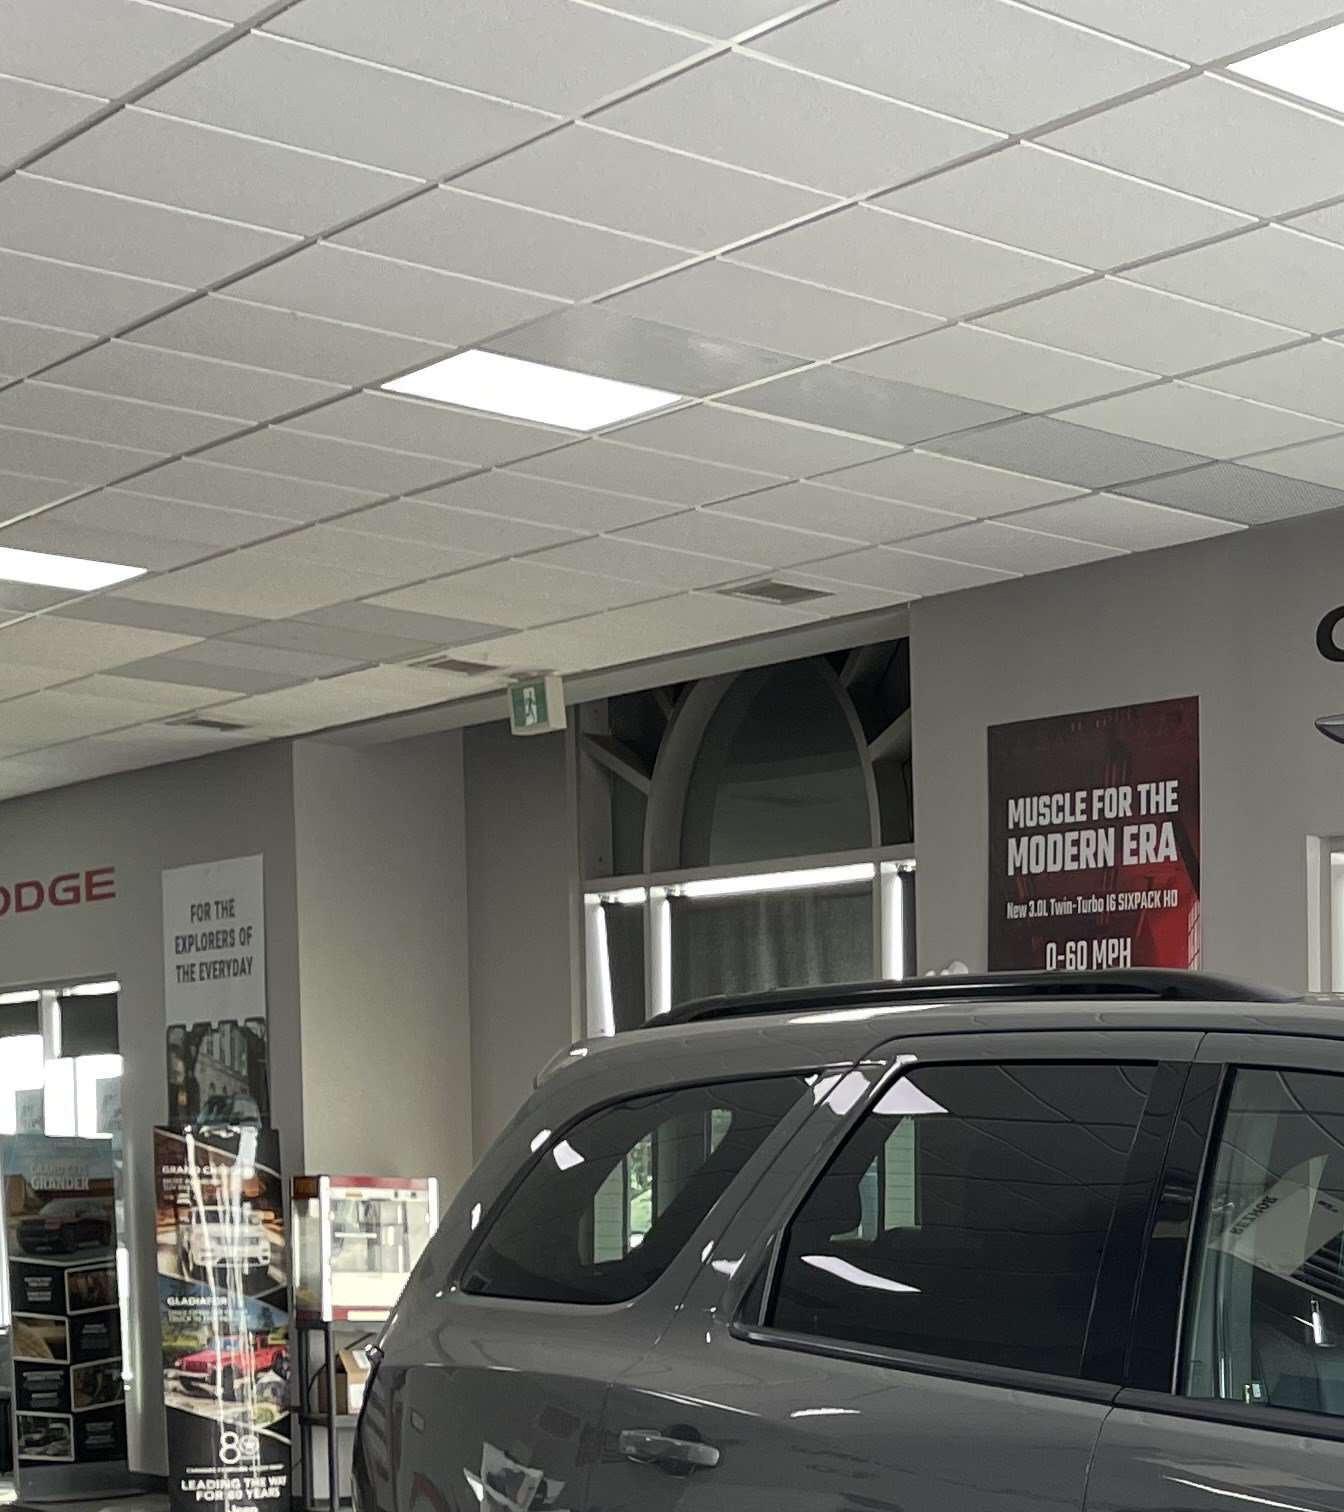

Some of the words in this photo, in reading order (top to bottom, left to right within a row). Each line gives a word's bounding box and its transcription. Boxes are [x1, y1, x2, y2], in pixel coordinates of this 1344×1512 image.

[1007, 790, 1087, 830] MUSCLE
[1093, 786, 1132, 821] FOR
[1137, 780, 1179, 816] THE
[1007, 827, 1115, 876] MODERN
[1123, 821, 1178, 867] ERA
[190, 901, 211, 923] FOR
[214, 898, 235, 918] THE
[1007, 902, 1027, 920] New
[1029, 899, 1048, 918] 3.0L
[1050, 894, 1104, 915] Twin-Turbo
[1118, 889, 1161, 911] SIXPACK
[175, 928, 236, 954] EXPLORERS
[239, 926, 253, 946] OF
[1046, 940, 1086, 971] 0-60
[1092, 937, 1132, 970] MPH
[176, 963, 196, 984] THE
[199, 956, 253, 983] EVERYDAY
[181, 1479, 241, 1491] LEADING
